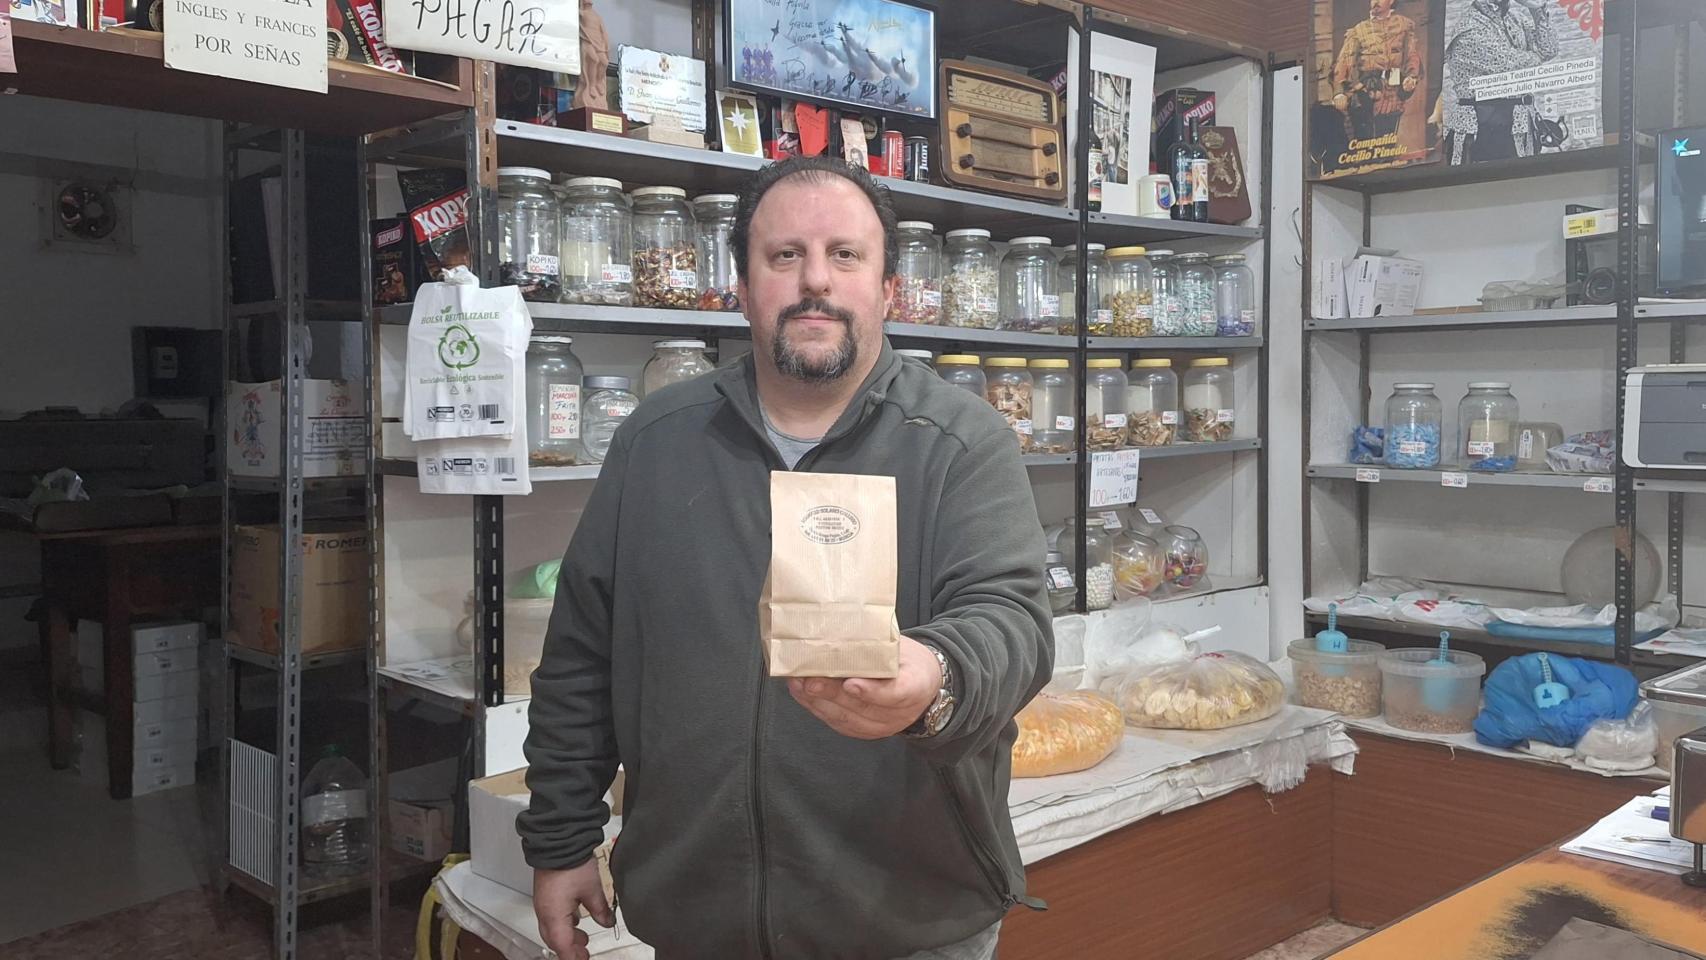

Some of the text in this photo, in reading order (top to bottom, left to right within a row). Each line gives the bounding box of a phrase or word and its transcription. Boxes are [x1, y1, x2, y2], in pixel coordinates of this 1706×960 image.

[176, 1, 317, 38] INGLES Y FRANCES
[195, 34, 301, 66] POR SEÑAS
[1470, 59, 1594, 88] Compañía Teatral Cecilio Pineda
[1477, 73, 1593, 99] Dirección Julio Navarro Albero
[1184, 100, 1214, 126] OPIKO
[1338, 144, 1408, 165] Cecilio Pineda
[1348, 132, 1399, 151] Compañía
[919, 144, 929, 172] Juan
[529, 257, 557, 265] KOPIKO
[420, 311, 500, 324] BOLSA REUTILIZABLE
[446, 374, 476, 384] Ecológica
